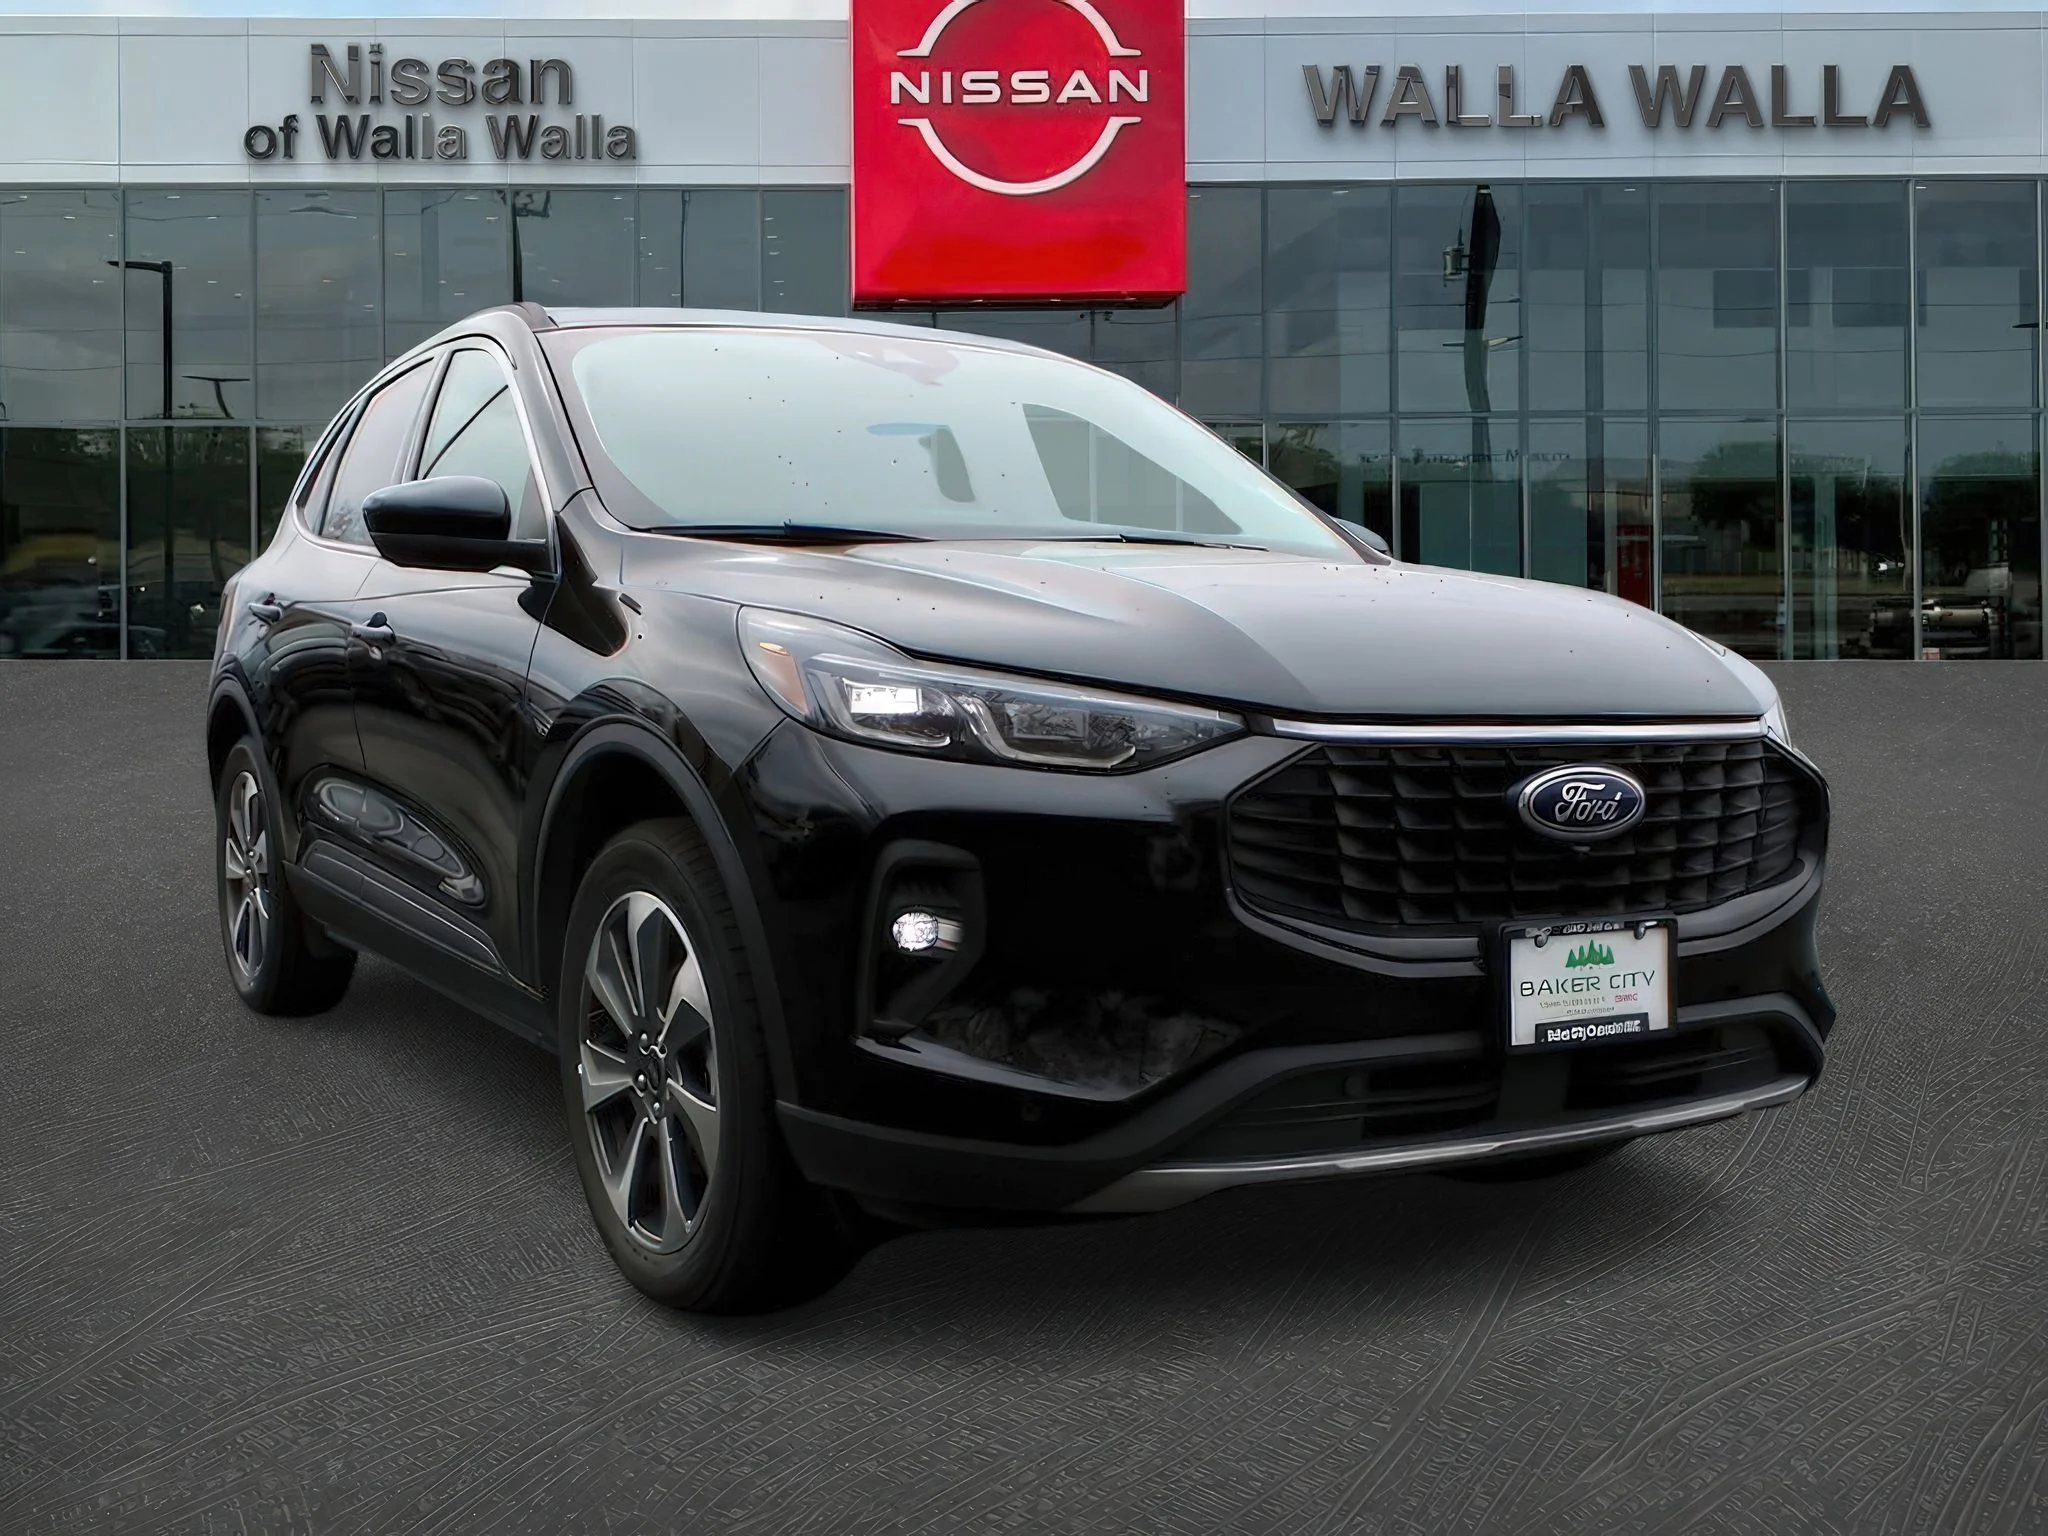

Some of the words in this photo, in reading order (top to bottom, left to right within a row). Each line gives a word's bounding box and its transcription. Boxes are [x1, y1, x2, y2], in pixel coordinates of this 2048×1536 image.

[310, 42, 573, 105] Nissan
[890, 70, 1148, 104] NISSAN
[1302, 63, 1605, 128] WALLA
[1627, 63, 1932, 128] WALLA
[243, 114, 298, 160] of
[316, 113, 468, 160] Walla
[485, 113, 638, 160] Walla
[1555, 782, 1622, 822] Ford
[1520, 976, 1601, 997] BAKER
[1609, 970, 1656, 989] CITY
